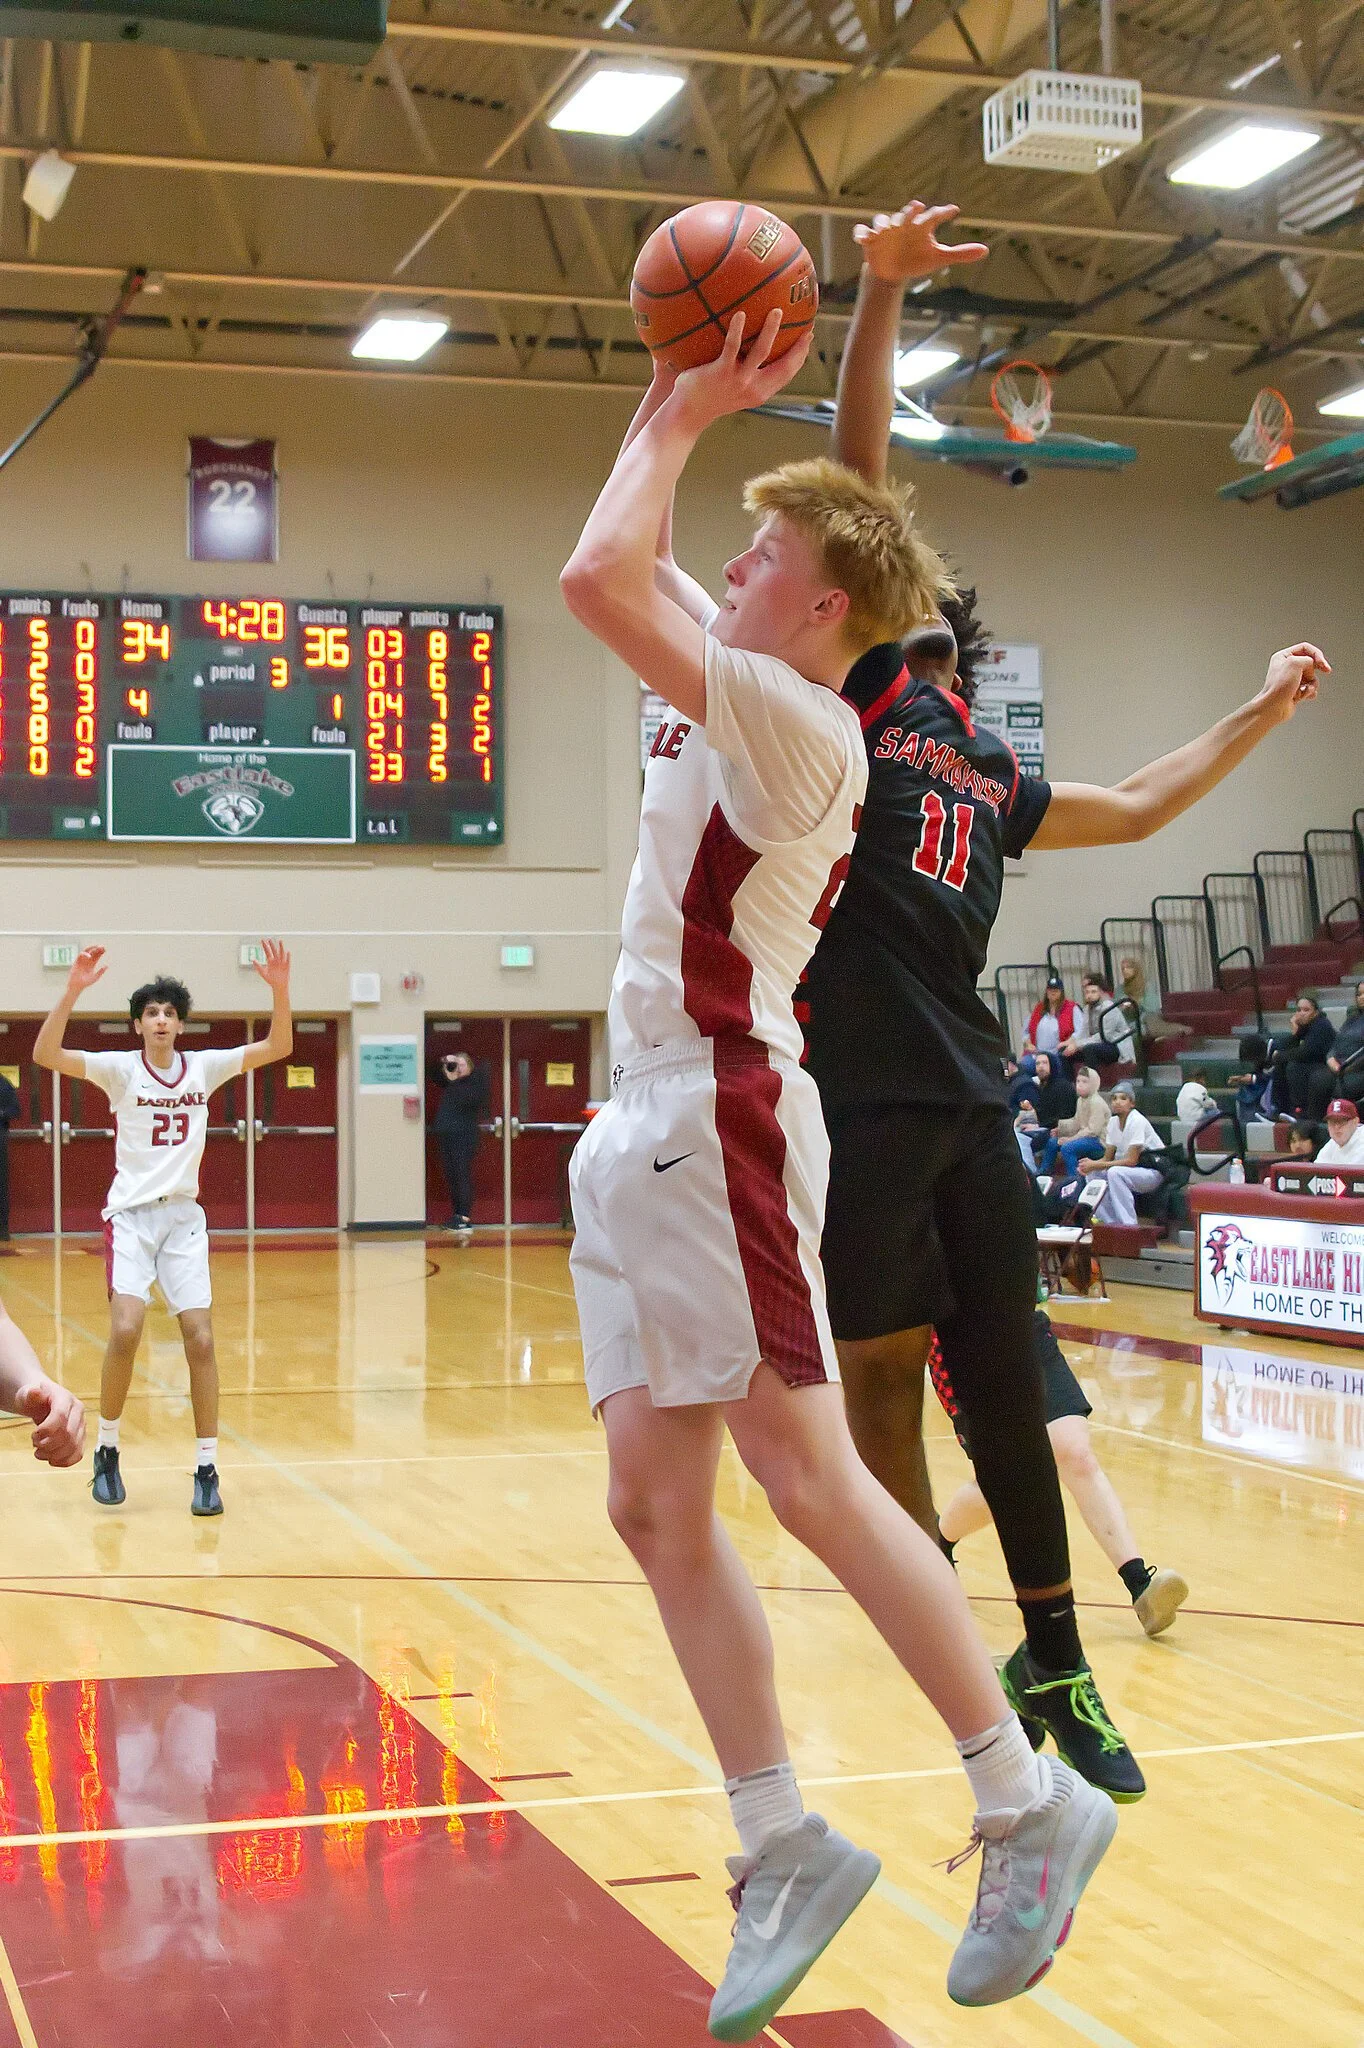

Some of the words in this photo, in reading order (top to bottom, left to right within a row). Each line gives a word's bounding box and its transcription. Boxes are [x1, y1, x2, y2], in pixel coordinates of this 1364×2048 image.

[209, 480, 256, 512] 22
[62, 598, 99, 617] fouls
[121, 599, 163, 618] Home
[203, 600, 285, 641] 4:28
[298, 605, 348, 625] Guests
[458, 611, 494, 630] fouls
[29, 619, 49, 650] 5
[75, 620, 95, 651] 0
[122, 620, 170, 663] 34
[304, 626, 350, 668] 36
[367, 629, 403, 660] 03
[428, 630, 448, 661] 8
[473, 632, 491, 662] 2
[29, 650, 49, 681] 2
[75, 651, 95, 682] 0
[209, 663, 256, 684] period
[270, 656, 290, 689] 3
[367, 660, 403, 690] 01
[428, 661, 448, 691] 6
[482, 664, 491, 691] 1
[29, 681, 49, 713] 5
[76, 683, 95, 714] 3
[127, 686, 149, 718] 4
[332, 693, 343, 720] 1
[367, 690, 403, 720] 04
[431, 691, 448, 720] 7
[473, 694, 491, 722] 2
[29, 713, 49, 745] 8
[75, 714, 95, 745] 0
[116, 721, 153, 740] fouls
[209, 722, 257, 743] player
[312, 725, 347, 744] fouls
[367, 721, 403, 751] 21
[430, 722, 448, 753] 3
[473, 724, 491, 754] 2
[29, 745, 49, 776] 0
[75, 746, 94, 777] 2
[198, 752, 233, 764] Home
[235, 752, 247, 764] of
[249, 753, 267, 765] the
[1011, 741, 1041, 752] 2014
[172, 763, 295, 797] Eastlake
[368, 752, 403, 782] 33
[429, 752, 448, 782] 5
[482, 756, 491, 782] 1
[911, 789, 975, 893] 11
[136, 1092, 206, 1109] EASTLAKE
[1332, 1101, 1342, 1112] E
[152, 1112, 190, 1146] 23
[1316, 1178, 1337, 1194] POSS
[1249, 1244, 1336, 1294] EASTLAKE
[1342, 1250, 1364, 1297] HI
[1253, 1291, 1304, 1317] HOME
[1310, 1298, 1333, 1319] OF
